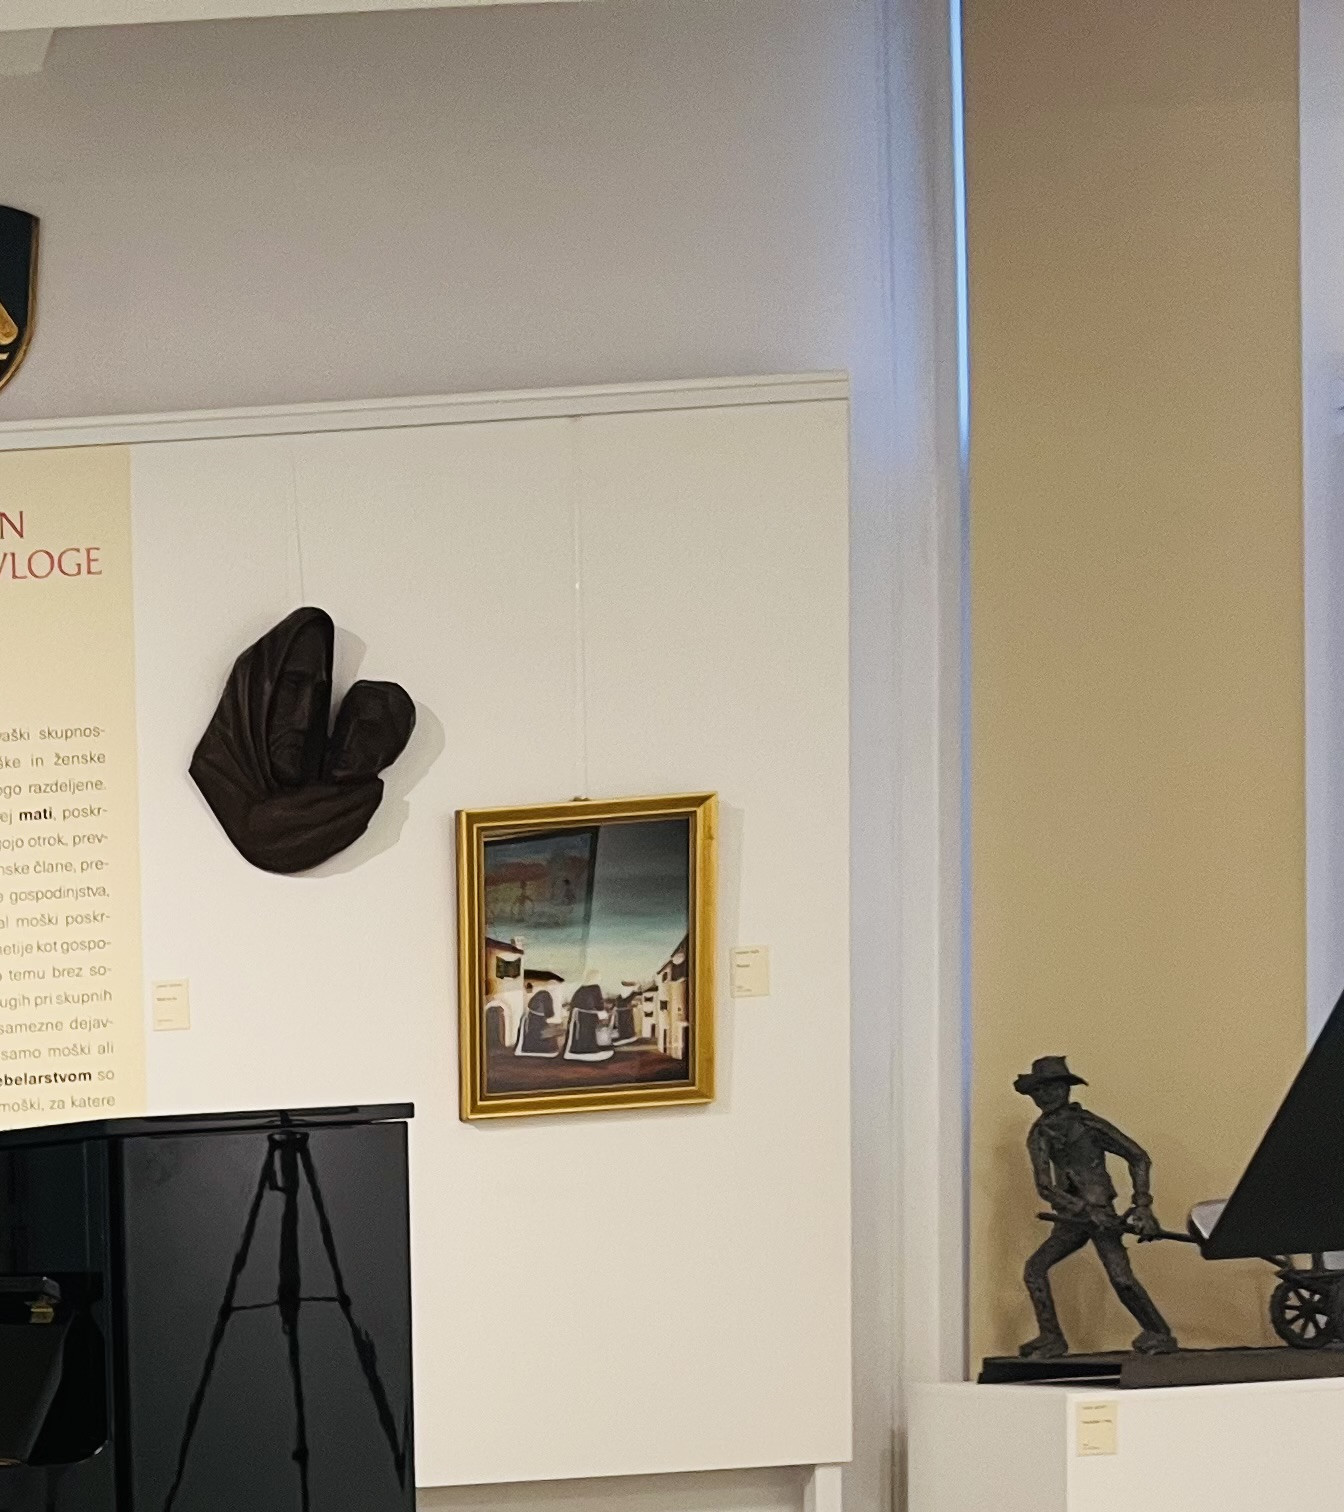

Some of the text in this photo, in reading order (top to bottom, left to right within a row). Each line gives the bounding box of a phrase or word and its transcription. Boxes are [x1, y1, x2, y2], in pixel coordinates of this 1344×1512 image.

[38, 724, 106, 743] skupnos-
[30, 753, 44, 768] in
[53, 750, 106, 766] ženske
[18, 806, 57, 823] mati,
[62, 804, 108, 823] poskr-
[72, 833, 108, 848] prev-
[80, 859, 109, 873] pre-
[15, 912, 59, 928] moški
[65, 910, 111, 928] poskr-
[36, 939, 58, 954] kot
[60, 937, 112, 955] gospo-
[8, 966, 46, 982] temu
[51, 964, 84, 979] brez
[89, 964, 112, 977] so-
[34, 992, 53, 1010] pri
[55, 988, 113, 1008] skupnih
[69, 1016, 113, 1034] dejav-
[0, 1047, 42, 1062] samo
[47, 1042, 91, 1059] moški
[97, 1040, 115, 1056] ali
[97, 1067, 115, 1082] so
[48, 1097, 66, 1110] za
[70, 1092, 116, 1109] katere
